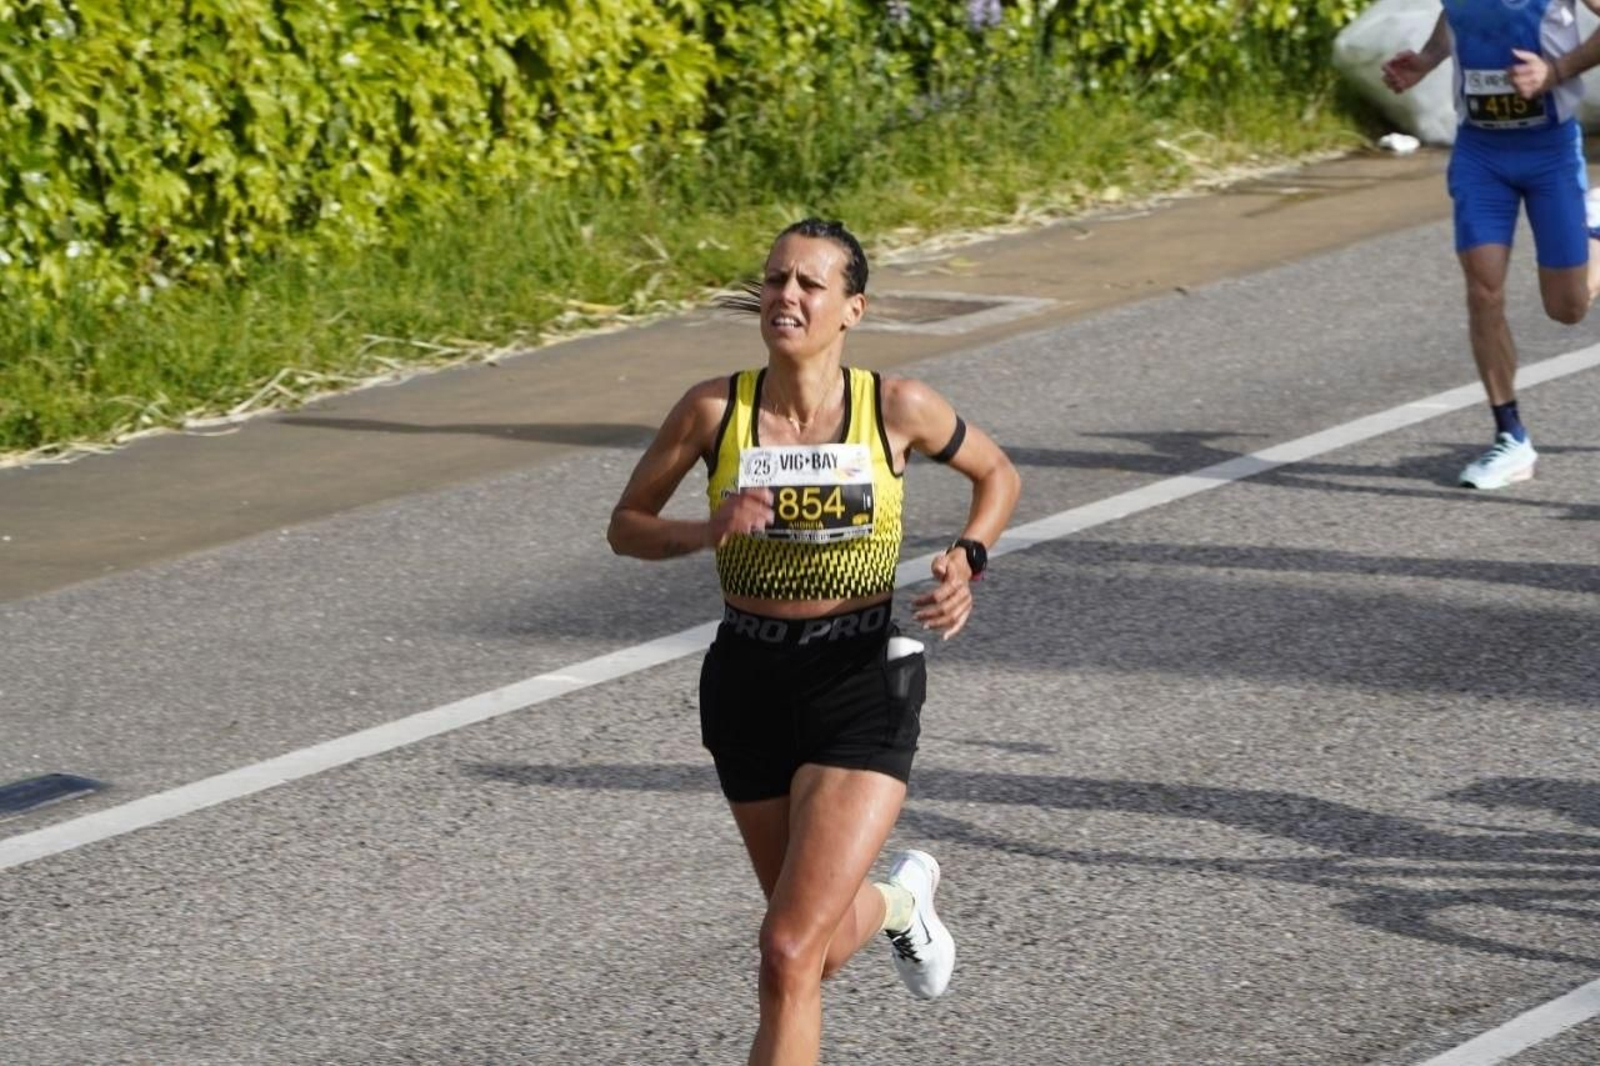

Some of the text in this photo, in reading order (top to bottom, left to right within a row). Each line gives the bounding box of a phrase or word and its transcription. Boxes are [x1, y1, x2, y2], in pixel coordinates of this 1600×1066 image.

[1485, 95, 1528, 114] 415
[754, 459, 771, 475] 25
[778, 486, 846, 521] 854
[725, 606, 886, 645] PRO PRO
